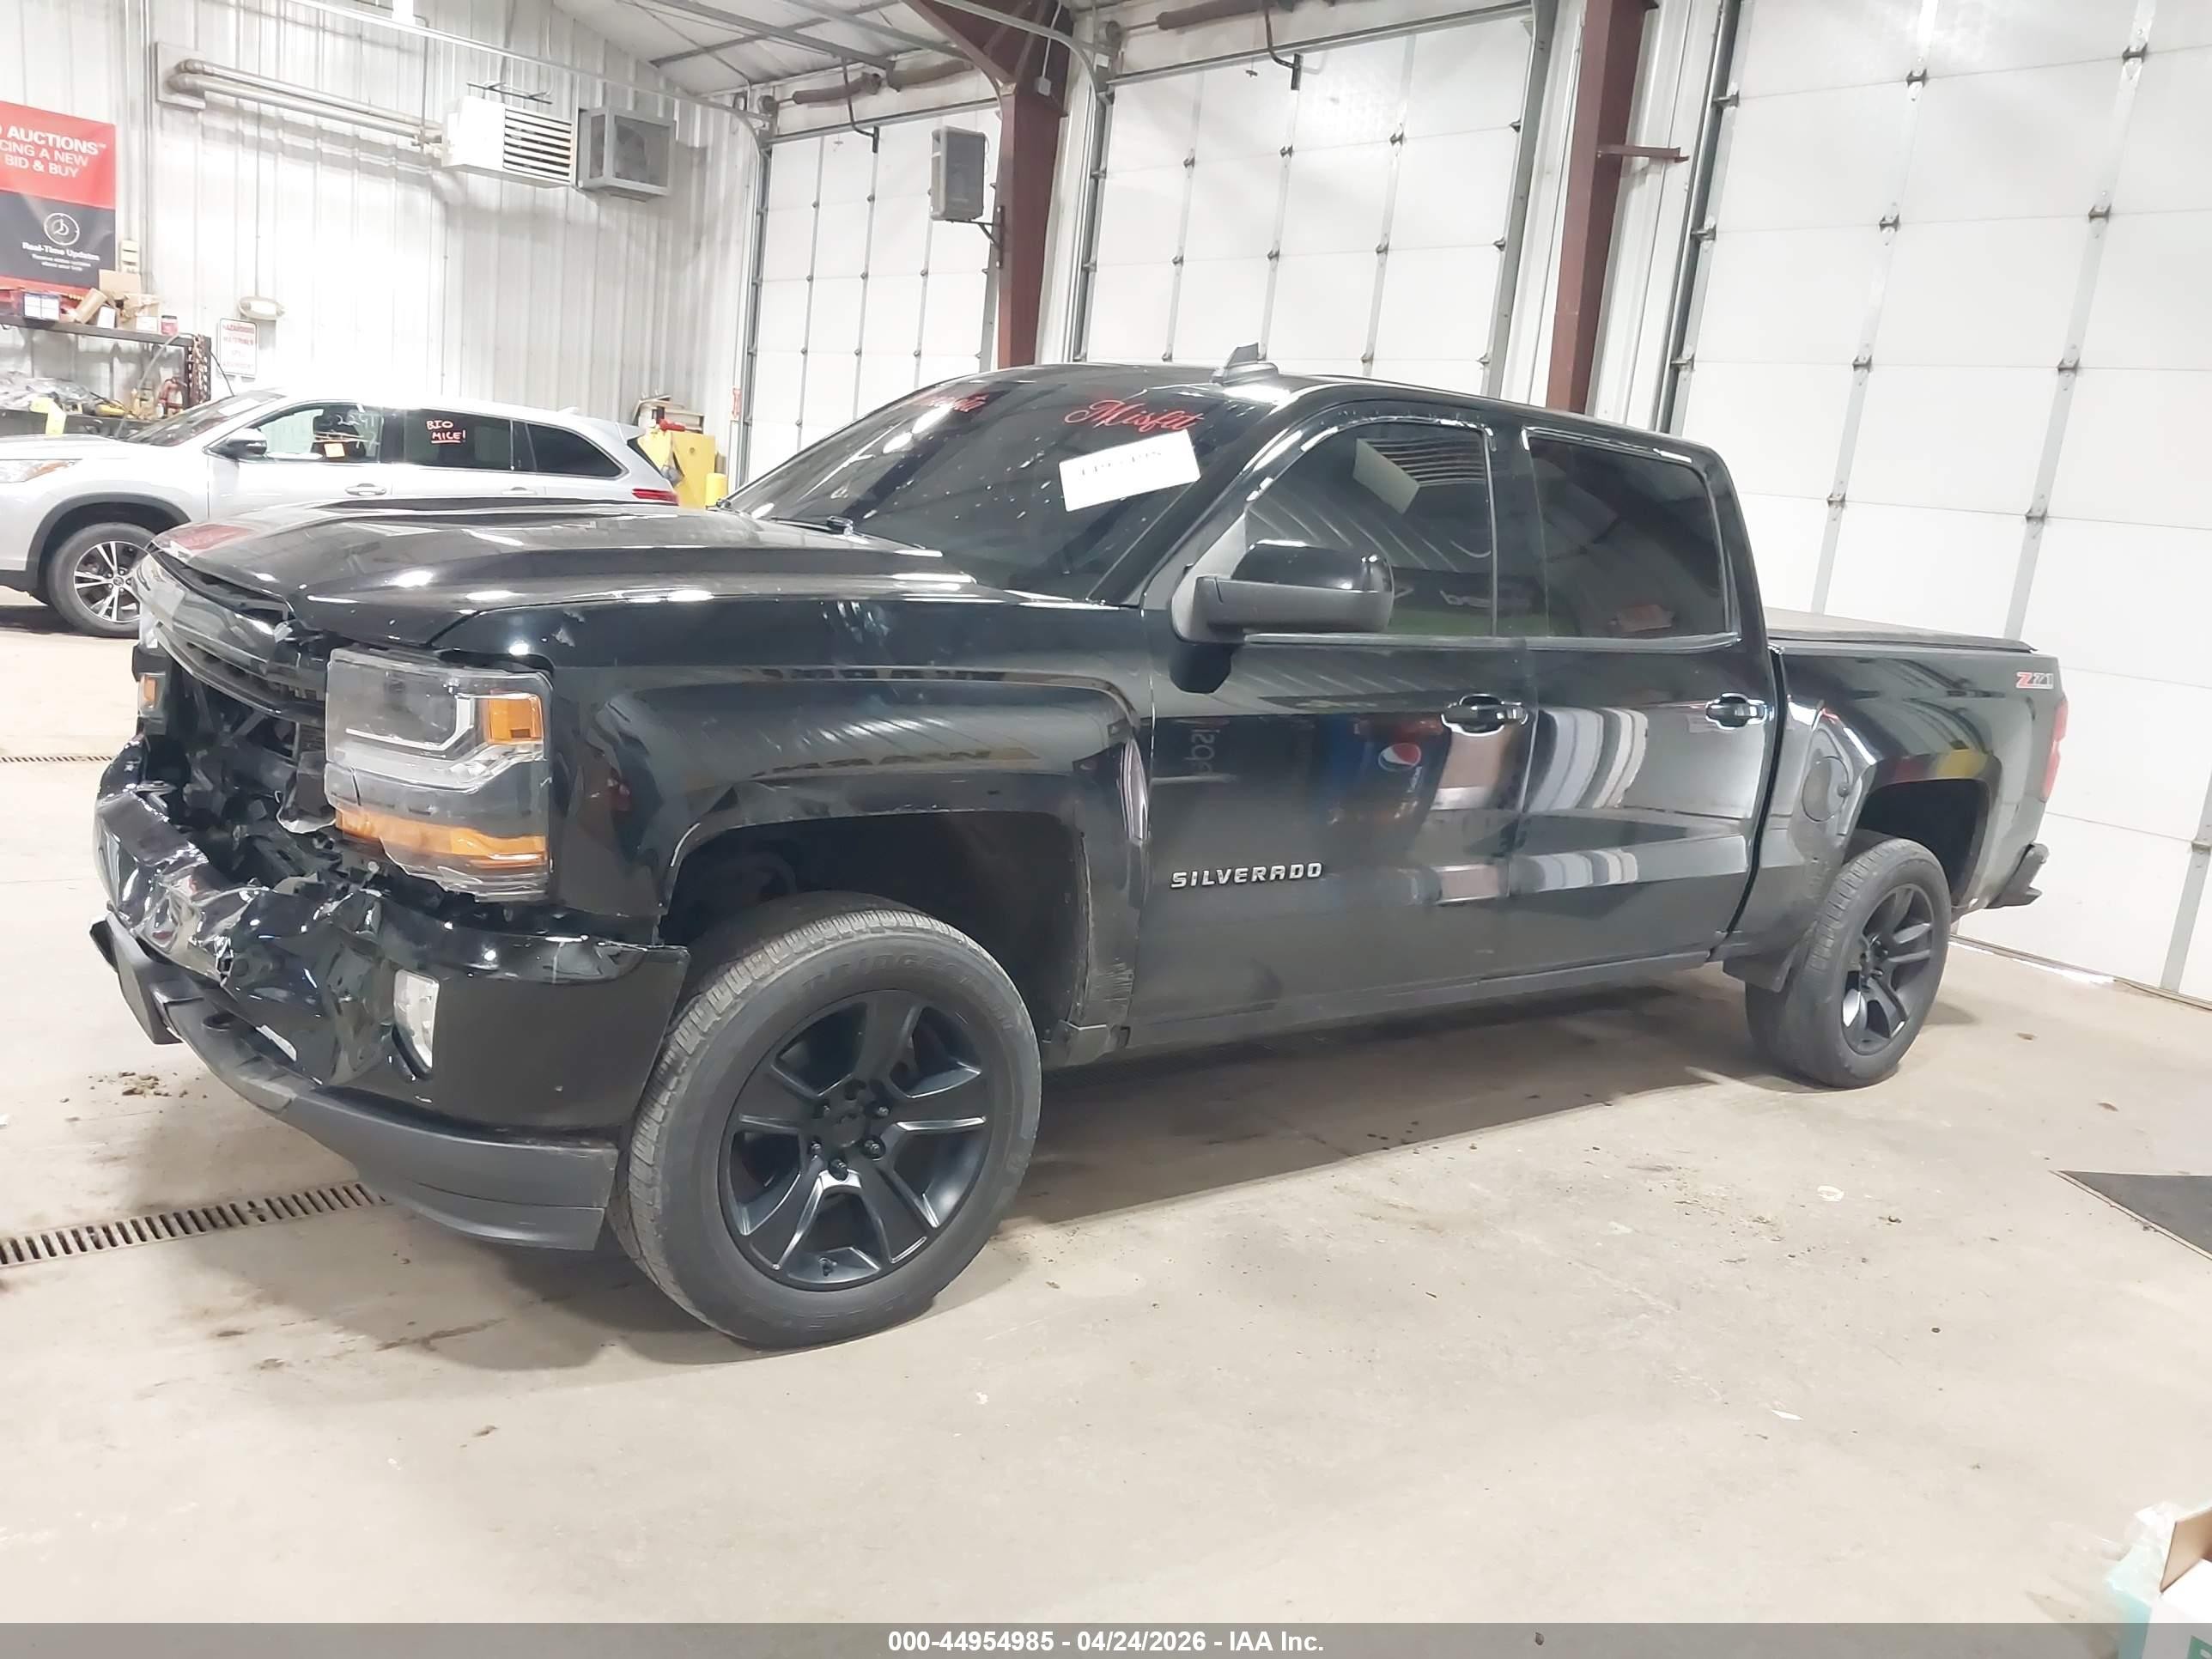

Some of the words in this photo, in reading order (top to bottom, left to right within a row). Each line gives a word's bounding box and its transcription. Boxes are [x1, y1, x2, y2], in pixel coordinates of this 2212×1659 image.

[5, 154, 29, 169] BID
[33, 160, 45, 172] &
[49, 162, 79, 178] BUY
[39, 148, 50, 160] A
[54, 150, 88, 167] NEW
[426, 420, 453, 430] BIO
[1064, 399, 1205, 433] Misfit
[432, 429, 466, 443] MICE!
[2015, 672, 2054, 690] Z71
[1170, 862, 1323, 888] SILVERADO
